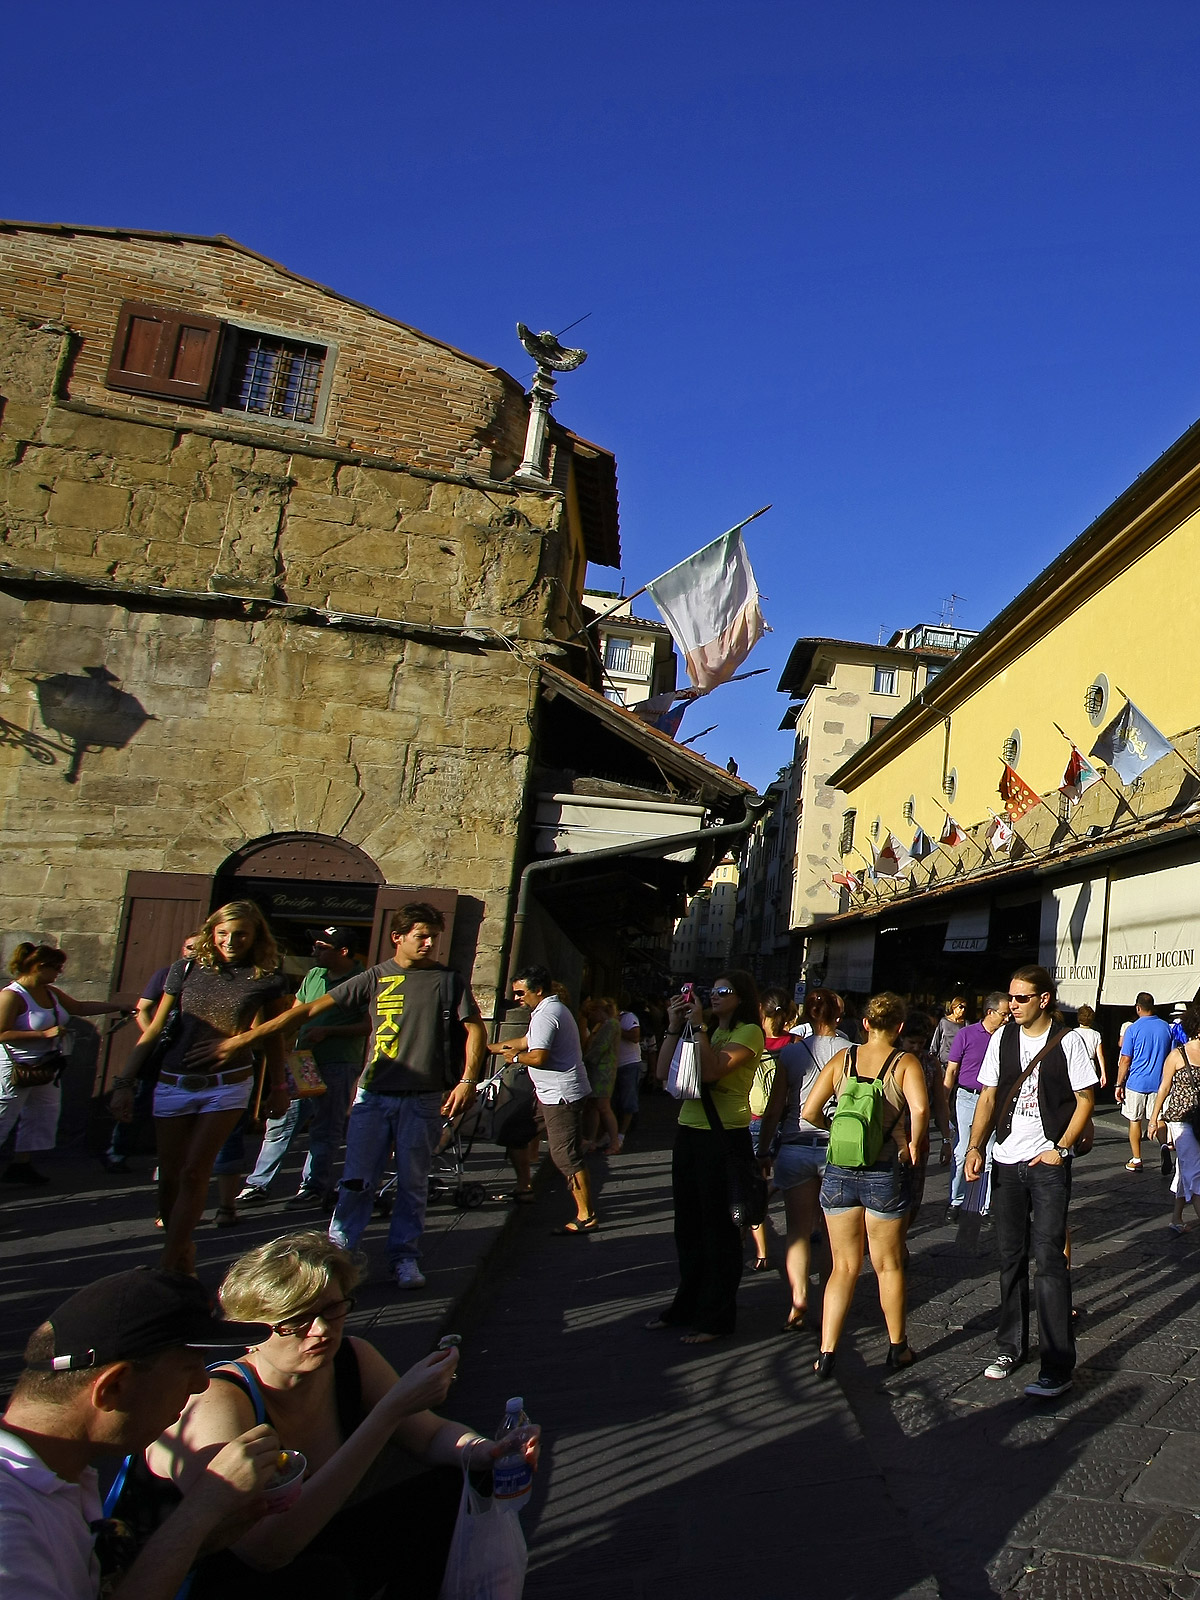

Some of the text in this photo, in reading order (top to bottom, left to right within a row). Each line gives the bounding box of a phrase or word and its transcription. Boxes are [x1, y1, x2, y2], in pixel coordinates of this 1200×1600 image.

[272, 893, 373, 912] Bridge Gallery
[1112, 949, 1195, 970] FRATELLI PICCINI
[1044, 965, 1097, 980] TELLI PICCINI
